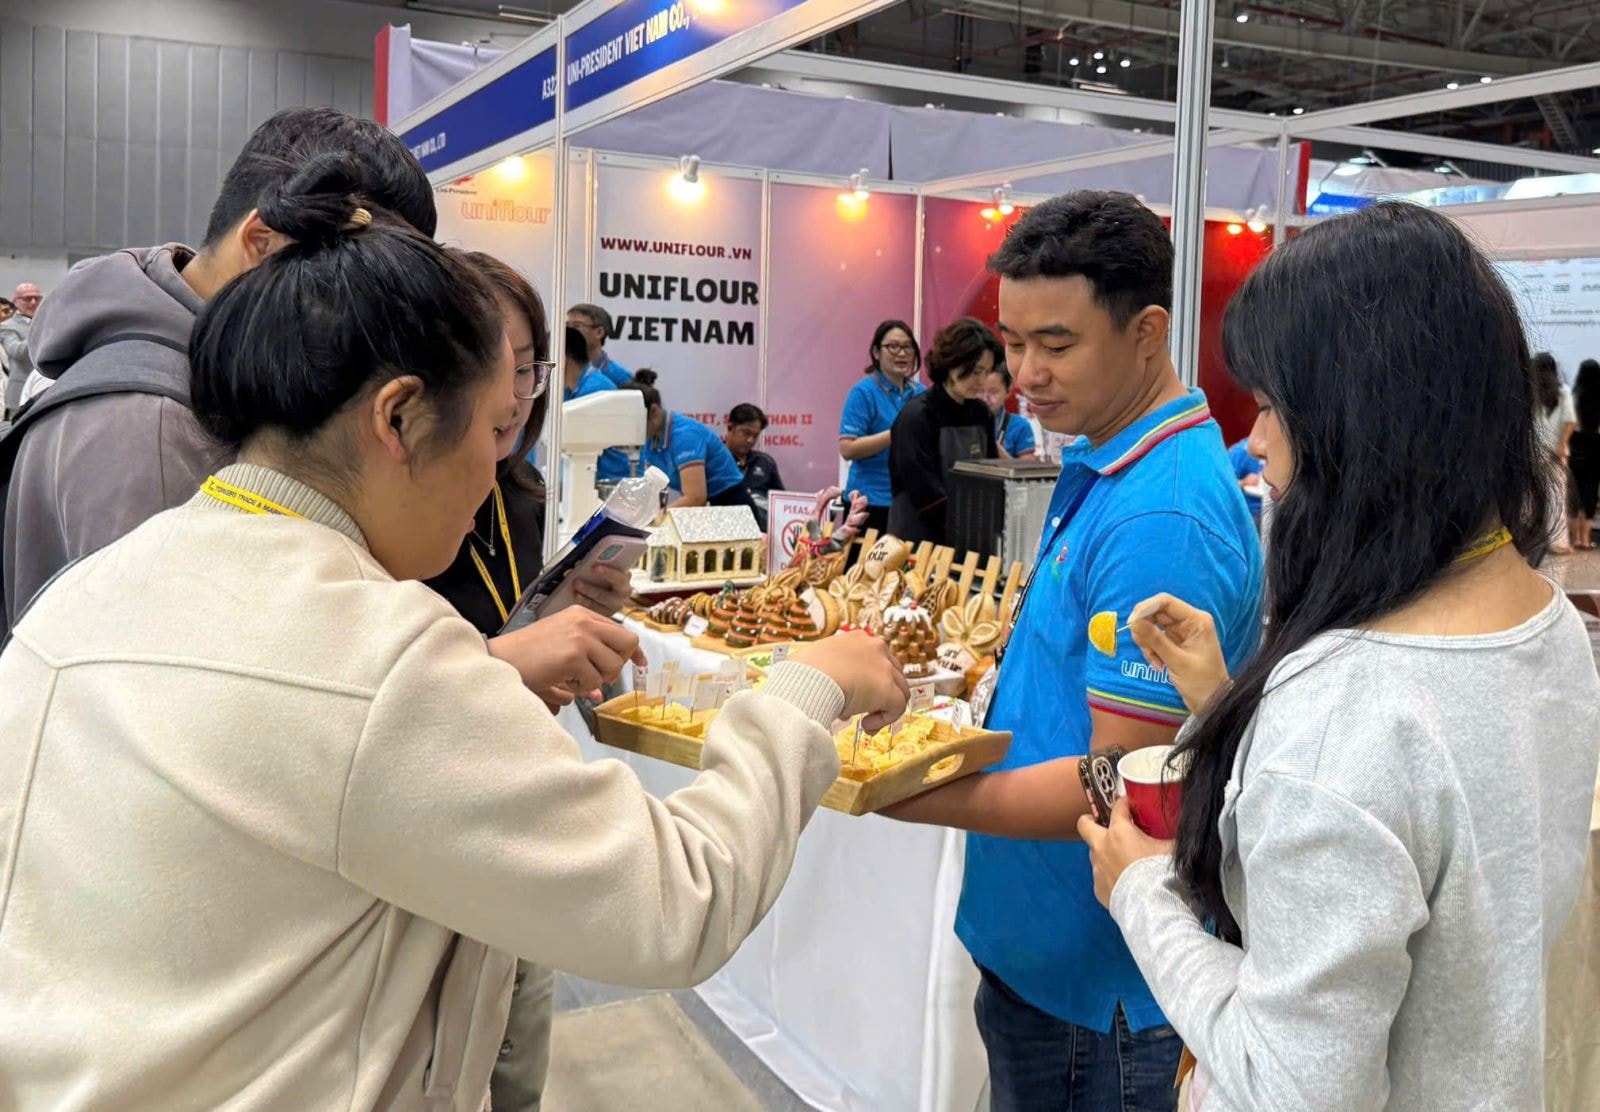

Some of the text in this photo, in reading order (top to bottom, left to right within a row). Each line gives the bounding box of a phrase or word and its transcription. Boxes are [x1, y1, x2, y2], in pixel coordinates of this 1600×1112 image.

[567, 35, 623, 86] UNI-PRESIDENT
[625, 22, 645, 56] VIET
[646, 9, 668, 45] NAM
[461, 199, 551, 225] uniflour
[599, 271, 760, 306] UNIFLOUR
[606, 314, 755, 346] VIETNAM
[783, 504, 811, 515] PLEAS
